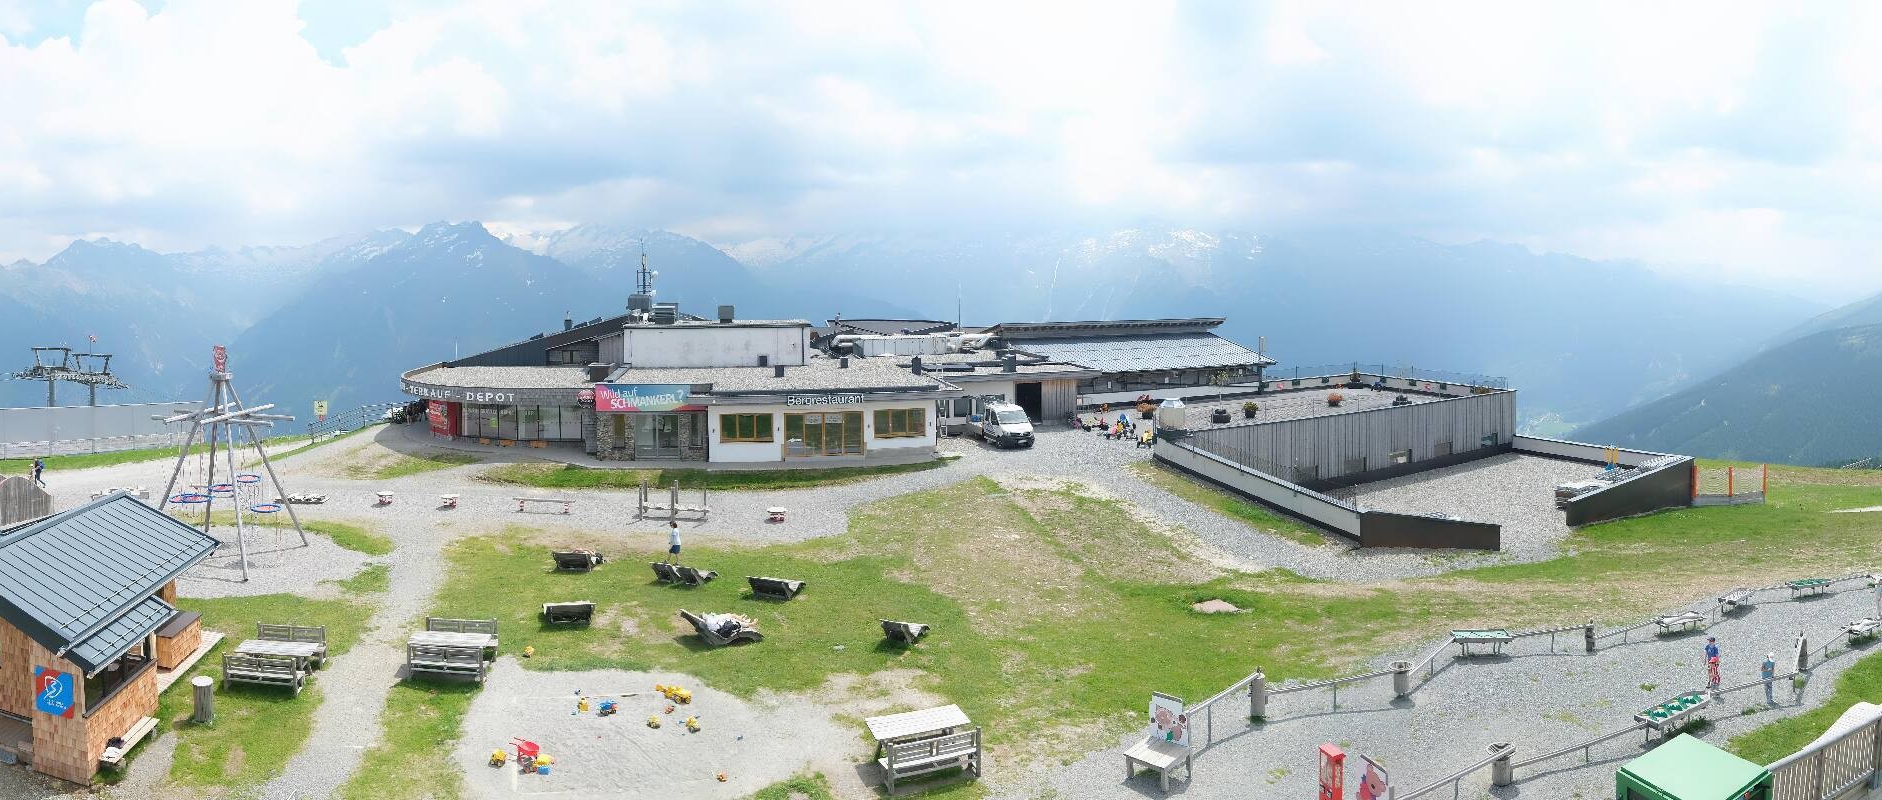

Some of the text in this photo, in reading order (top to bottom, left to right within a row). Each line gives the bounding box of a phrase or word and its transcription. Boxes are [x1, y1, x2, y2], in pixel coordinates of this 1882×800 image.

[466, 392, 515, 402] DEPOT
[600, 388, 621, 400] Wild
[622, 386, 638, 398] auf
[610, 389, 684, 409] SCHMANKERL?
[787, 393, 864, 408] Bergrestaurant
